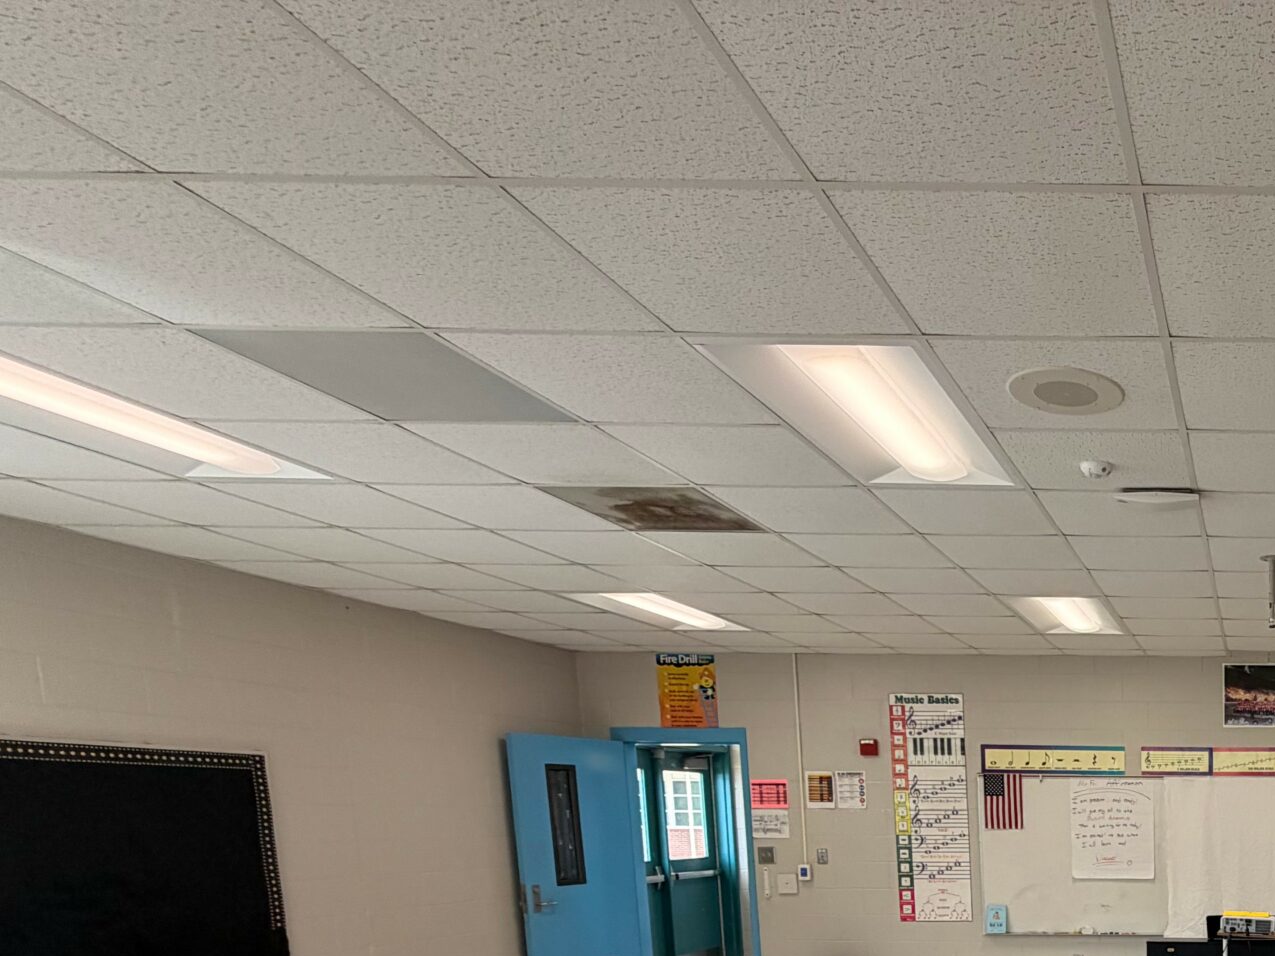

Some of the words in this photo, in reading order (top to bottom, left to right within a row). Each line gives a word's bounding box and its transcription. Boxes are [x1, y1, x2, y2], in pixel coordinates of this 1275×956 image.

[660, 654, 677, 664] Fire
[678, 654, 698, 664] Drill
[894, 695, 925, 704] Music
[927, 695, 960, 705] Basics
